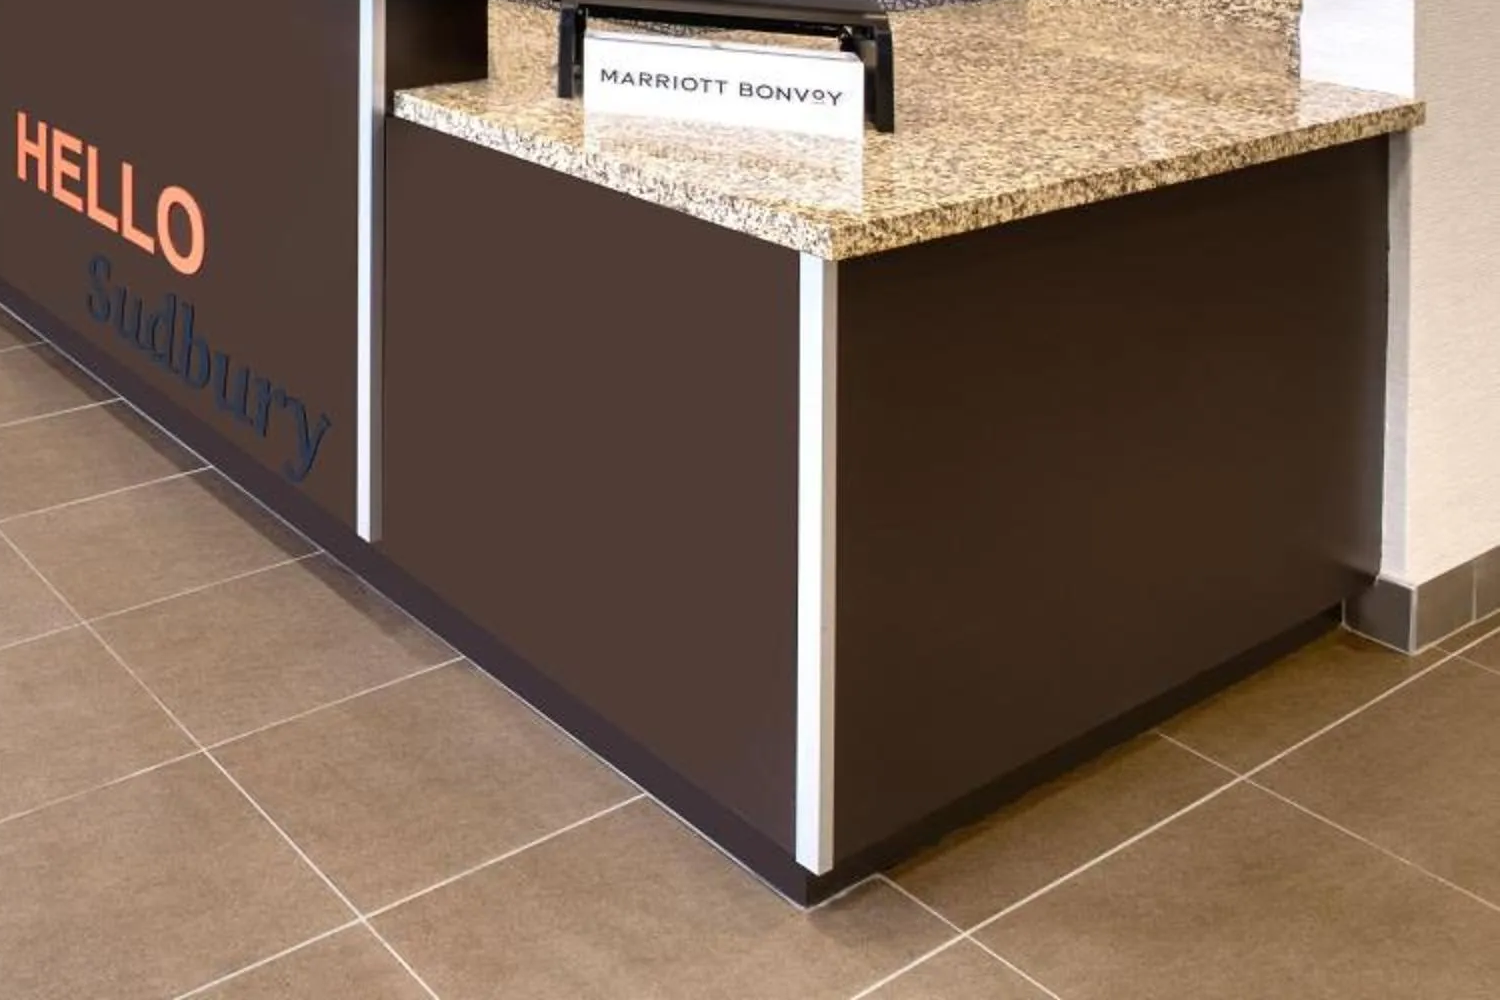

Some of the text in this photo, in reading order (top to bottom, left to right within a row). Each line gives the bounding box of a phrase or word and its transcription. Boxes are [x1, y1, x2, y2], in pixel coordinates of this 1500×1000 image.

[601, 68, 844, 106] MARRIOTT BONVOY
[17, 110, 204, 275] HELLO
[86, 254, 332, 483] Sudbury
